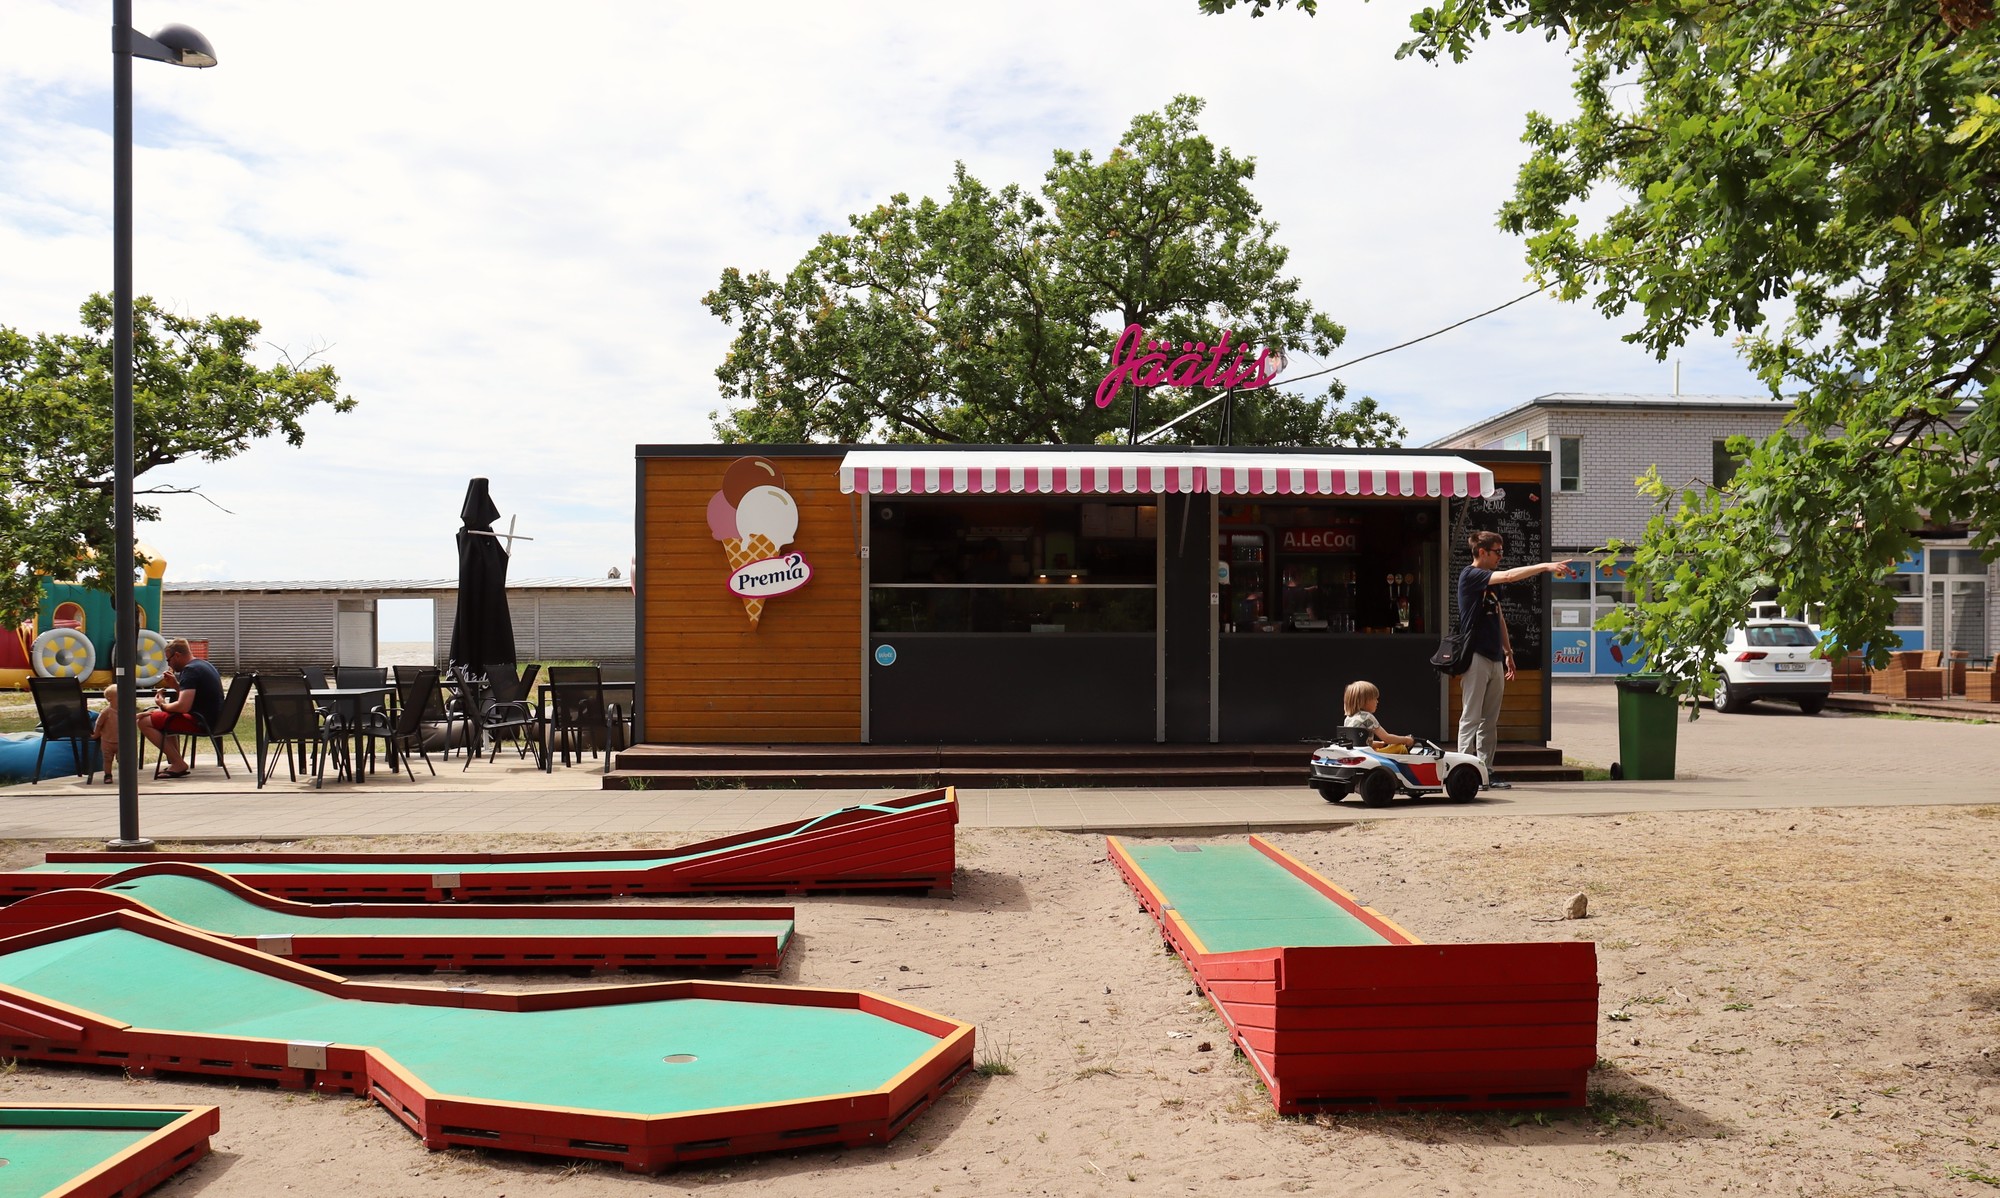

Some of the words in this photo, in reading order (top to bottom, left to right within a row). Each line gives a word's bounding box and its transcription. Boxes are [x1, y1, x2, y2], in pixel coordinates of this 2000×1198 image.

[1095, 323, 1276, 409] Jäätis
[738, 564, 804, 590] Premia
[1553, 649, 1585, 664] Food
[1563, 647, 1581, 655] FAST
